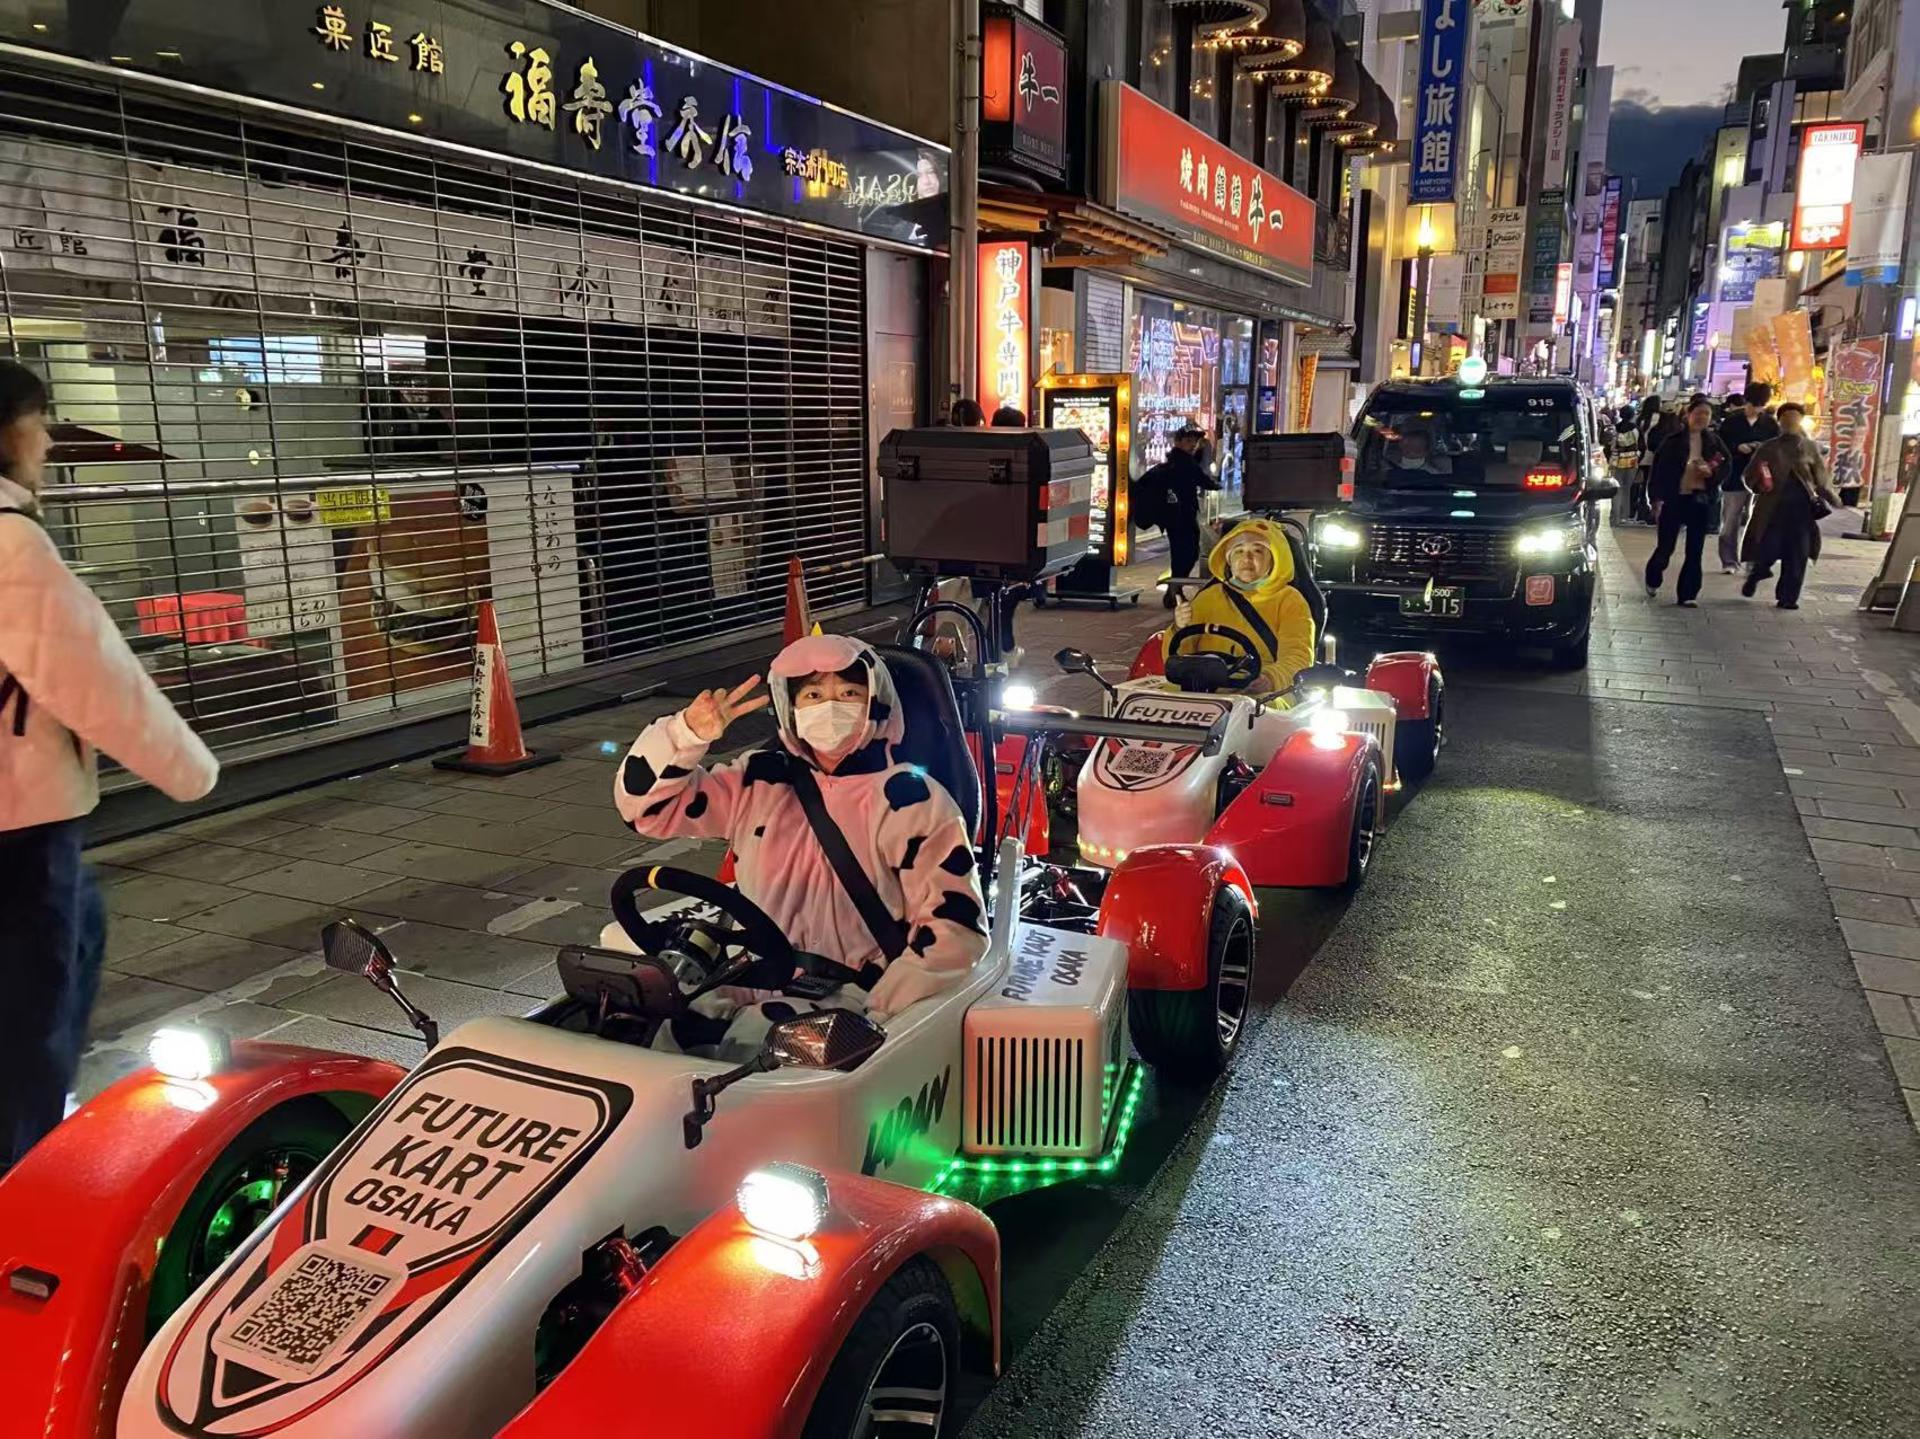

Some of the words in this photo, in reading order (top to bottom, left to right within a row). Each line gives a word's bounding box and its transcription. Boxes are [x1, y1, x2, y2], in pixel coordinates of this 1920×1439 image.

[315, 5, 444, 75] 菓匠館
[1018, 51, 1060, 113] 牛一
[1813, 131, 1855, 143] YAKINIKU
[1527, 398, 1555, 408] 915
[1129, 706, 1217, 723] FUTURE
[1050, 949, 1089, 986] OSAKA
[394, 1091, 582, 1165] FUTURE
[371, 1134, 526, 1202] KART
[344, 1177, 474, 1237] OSAKA
